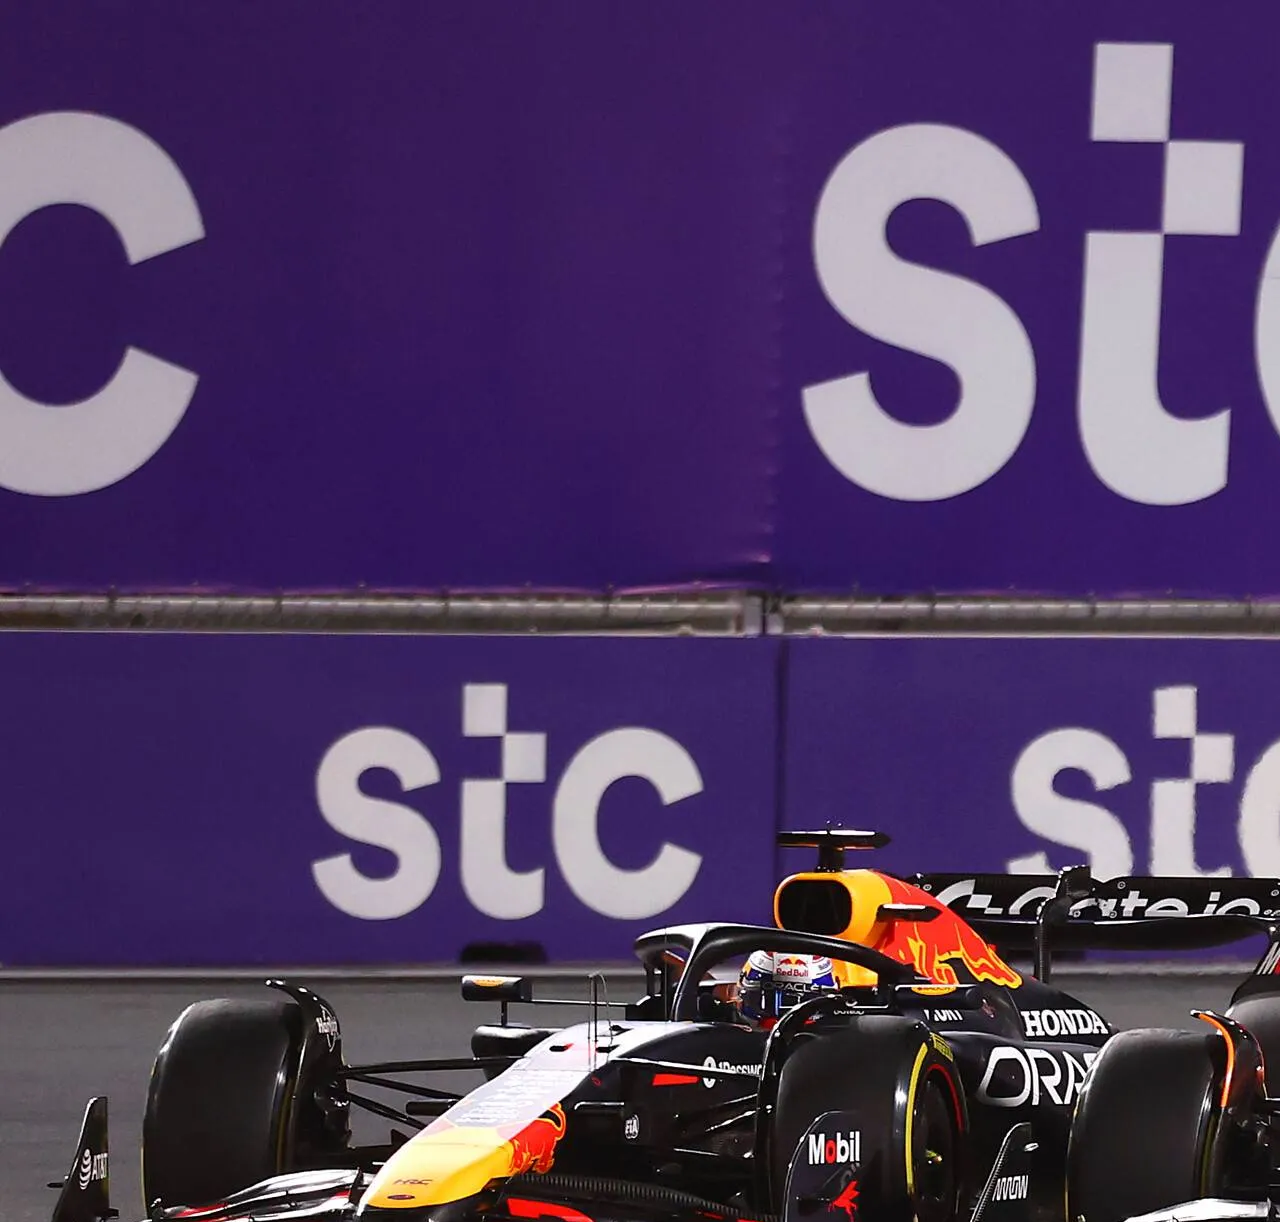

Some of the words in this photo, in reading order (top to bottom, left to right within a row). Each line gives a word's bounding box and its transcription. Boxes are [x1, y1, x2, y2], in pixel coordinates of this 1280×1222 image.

[312, 683, 704, 918] stc
[776, 968, 793, 976] Red
[793, 969, 809, 977] Bull
[1020, 1009, 1109, 1037] HONDA
[808, 1131, 860, 1165] Mobil
